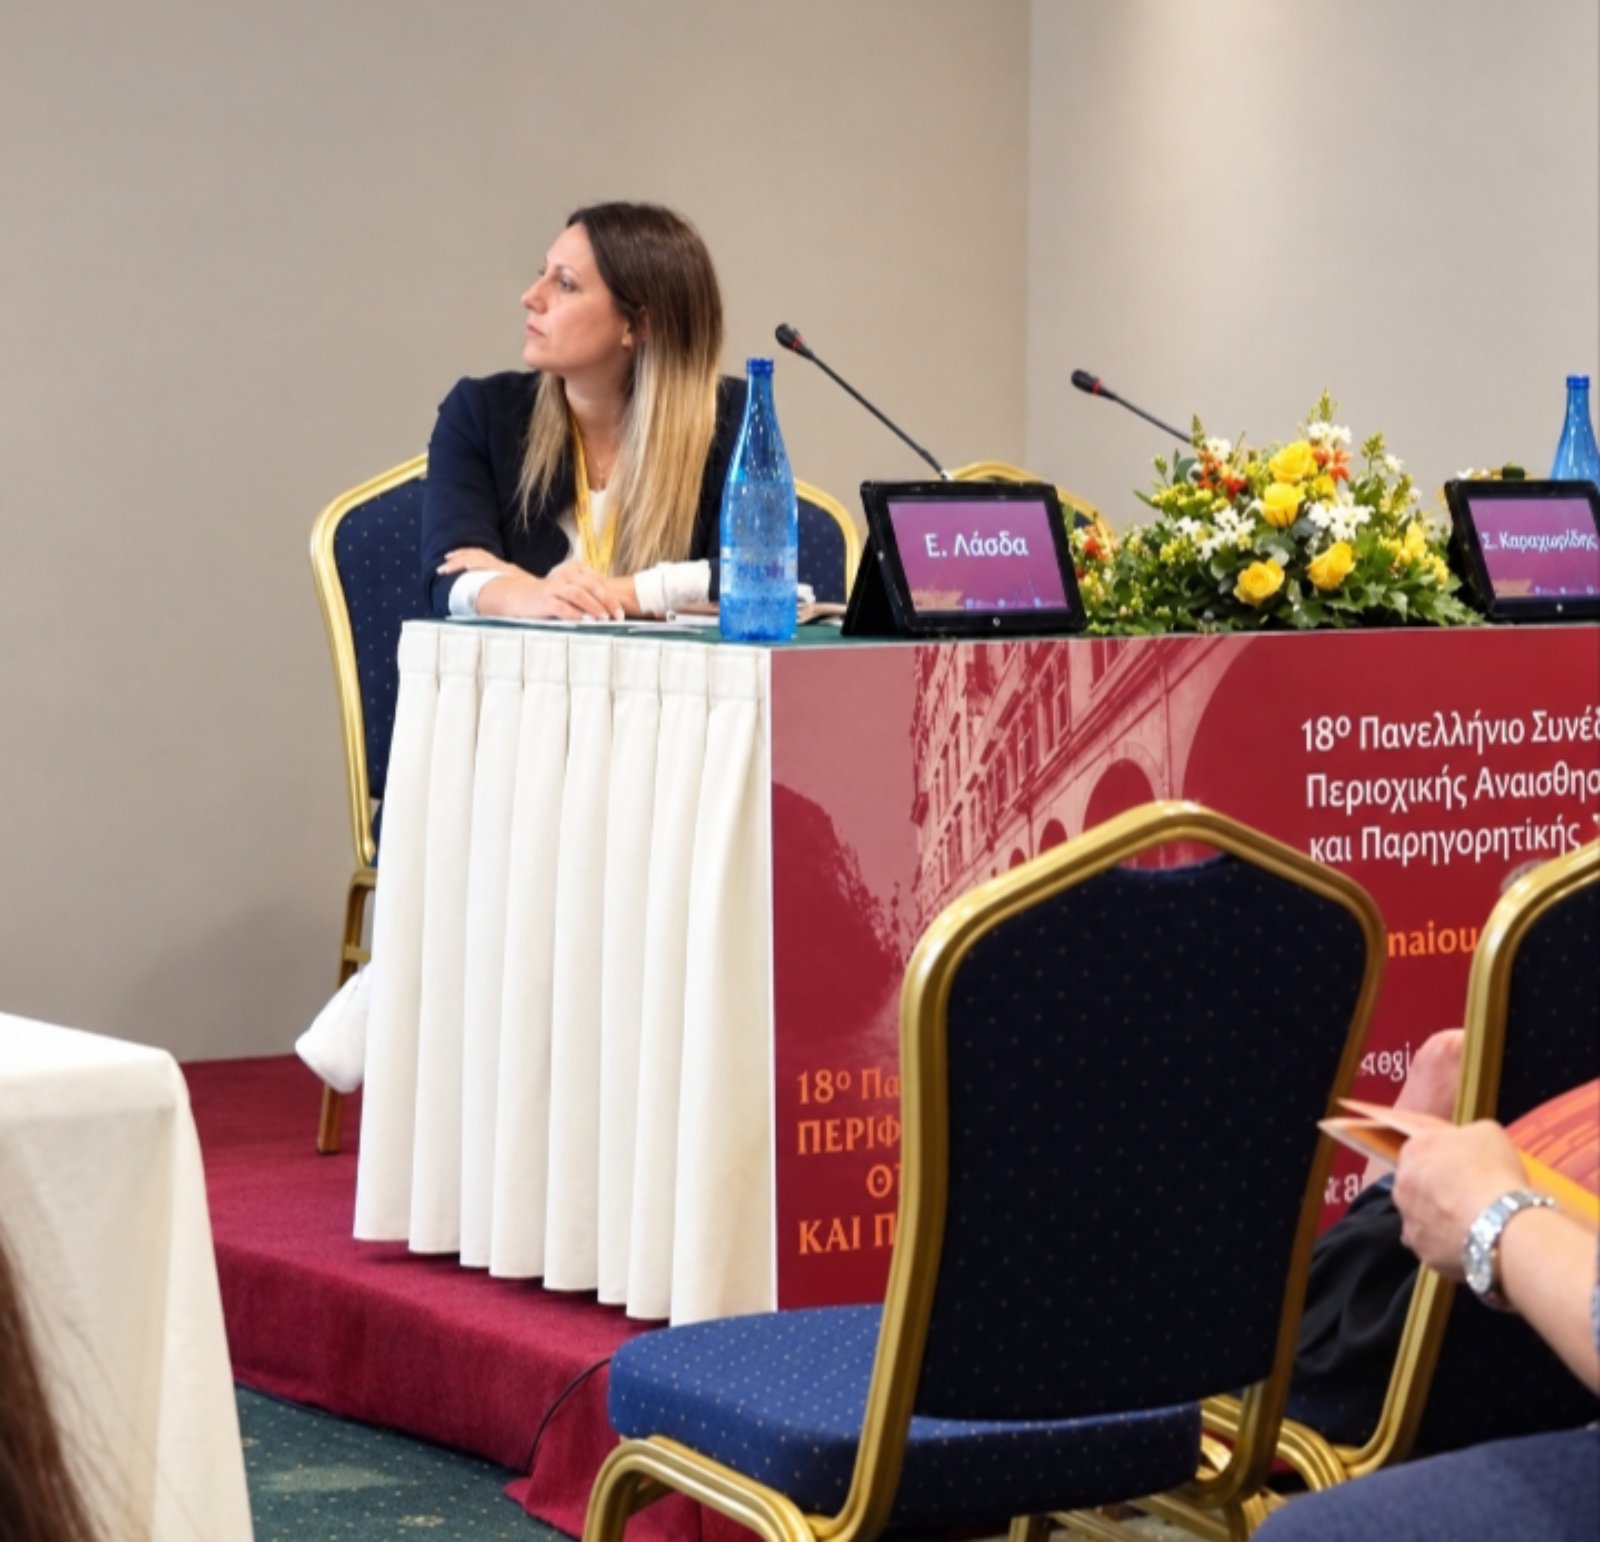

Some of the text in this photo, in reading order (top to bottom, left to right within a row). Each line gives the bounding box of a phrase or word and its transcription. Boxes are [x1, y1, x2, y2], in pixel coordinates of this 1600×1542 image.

[954, 531, 1029, 557] Λάσδα
[1359, 709, 1525, 755] Πανελλήνιο
[1306, 764, 1467, 816] Περιοχικής
[1310, 834, 1352, 863] και
[797, 1113, 900, 1155] ΠΕΡΙΦ
[798, 1215, 861, 1254] ΚΑΙ
